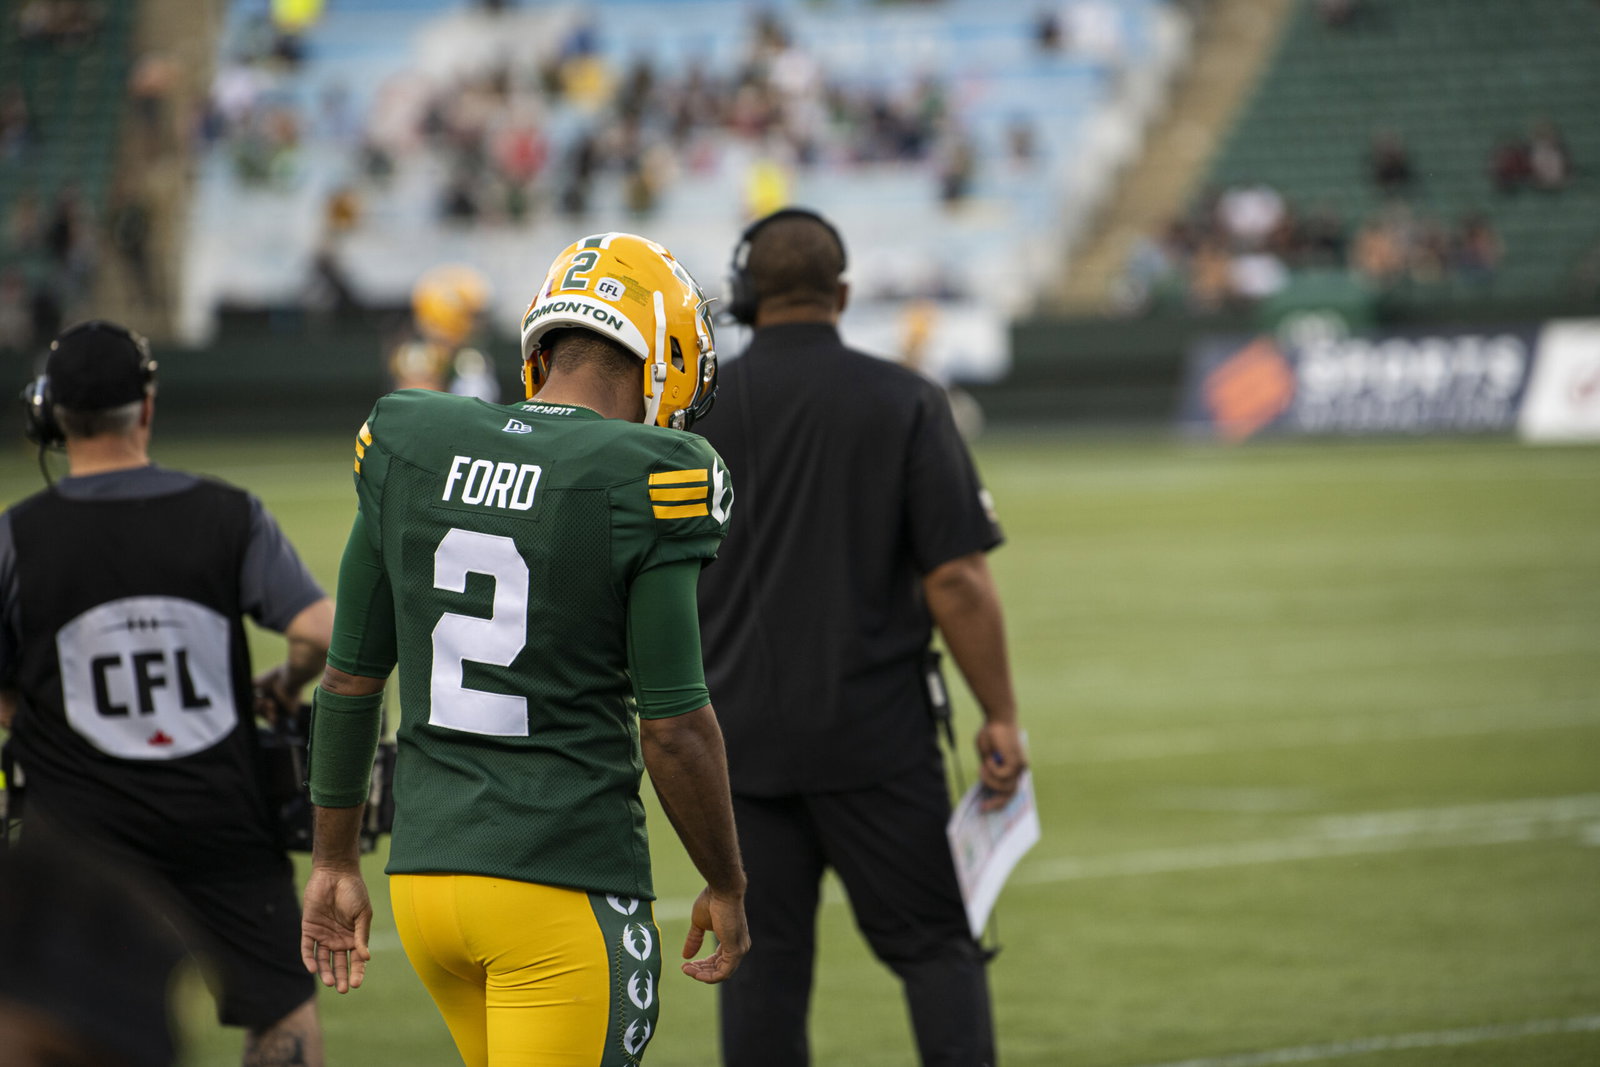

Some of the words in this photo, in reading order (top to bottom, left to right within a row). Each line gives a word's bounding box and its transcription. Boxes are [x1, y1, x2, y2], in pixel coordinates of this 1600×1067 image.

[561, 251, 599, 291] 2
[599, 282, 618, 297] CFL
[520, 404, 576, 416] TECHFIT
[442, 455, 542, 511] FORD
[428, 528, 530, 737] 2
[91, 648, 212, 718] CFL
